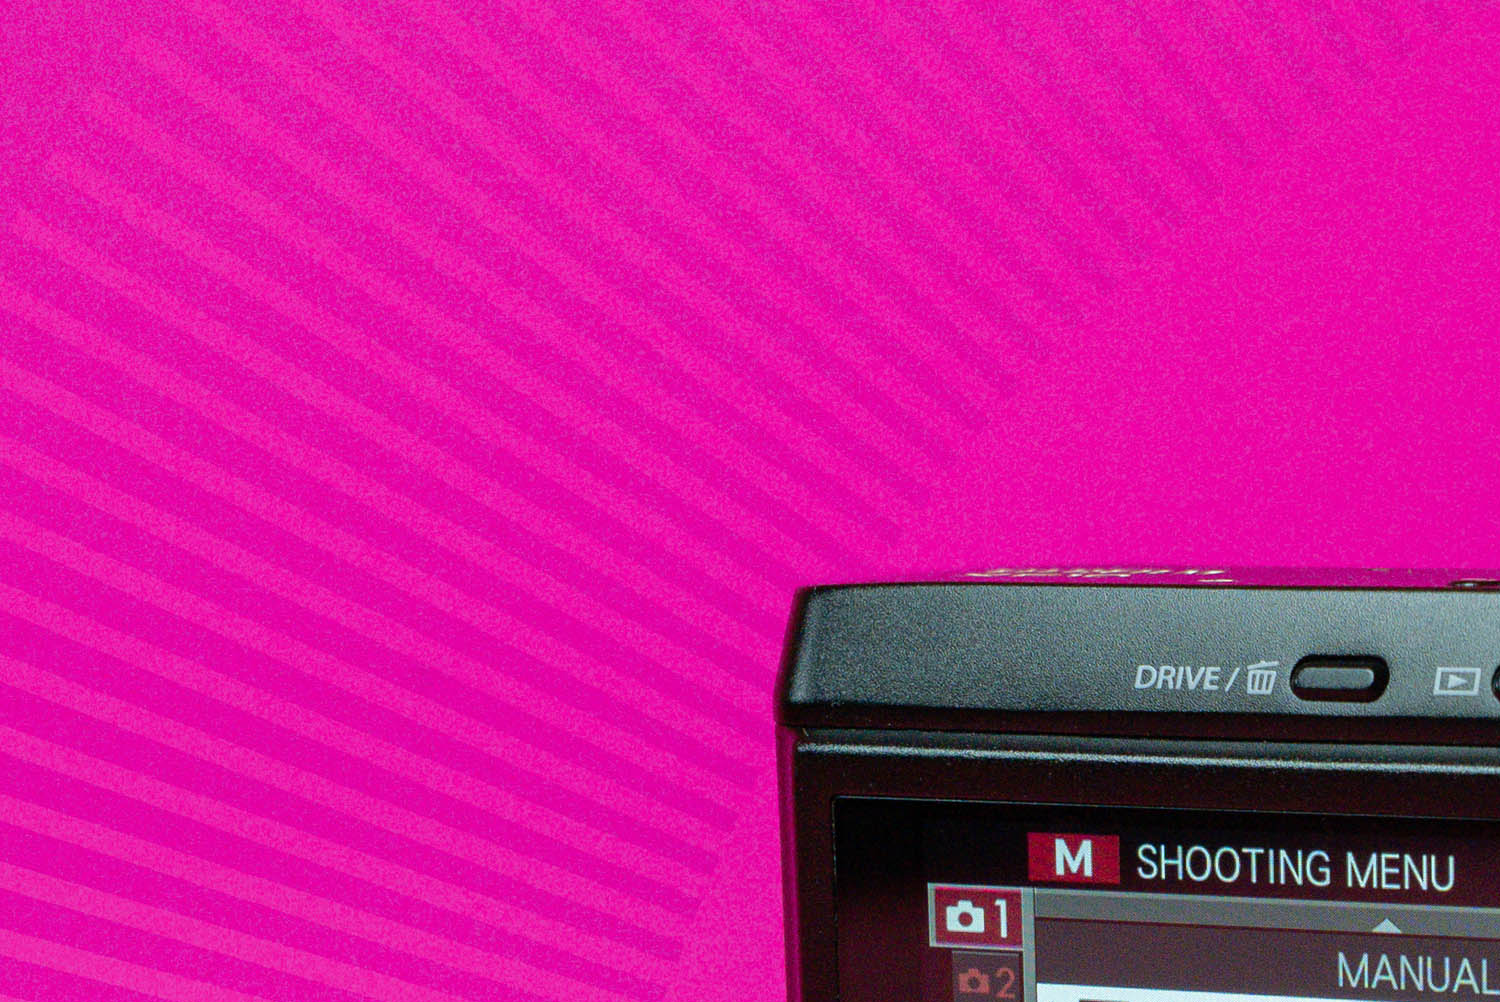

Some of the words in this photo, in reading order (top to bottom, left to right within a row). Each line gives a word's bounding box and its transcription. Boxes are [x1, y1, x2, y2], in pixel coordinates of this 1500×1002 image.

[1055, 838, 1093, 877] M
[1137, 843, 1331, 887] SHOOTING
[1346, 852, 1456, 892] MENU
[994, 898, 1008, 938] 1
[996, 967, 1016, 999] 2
